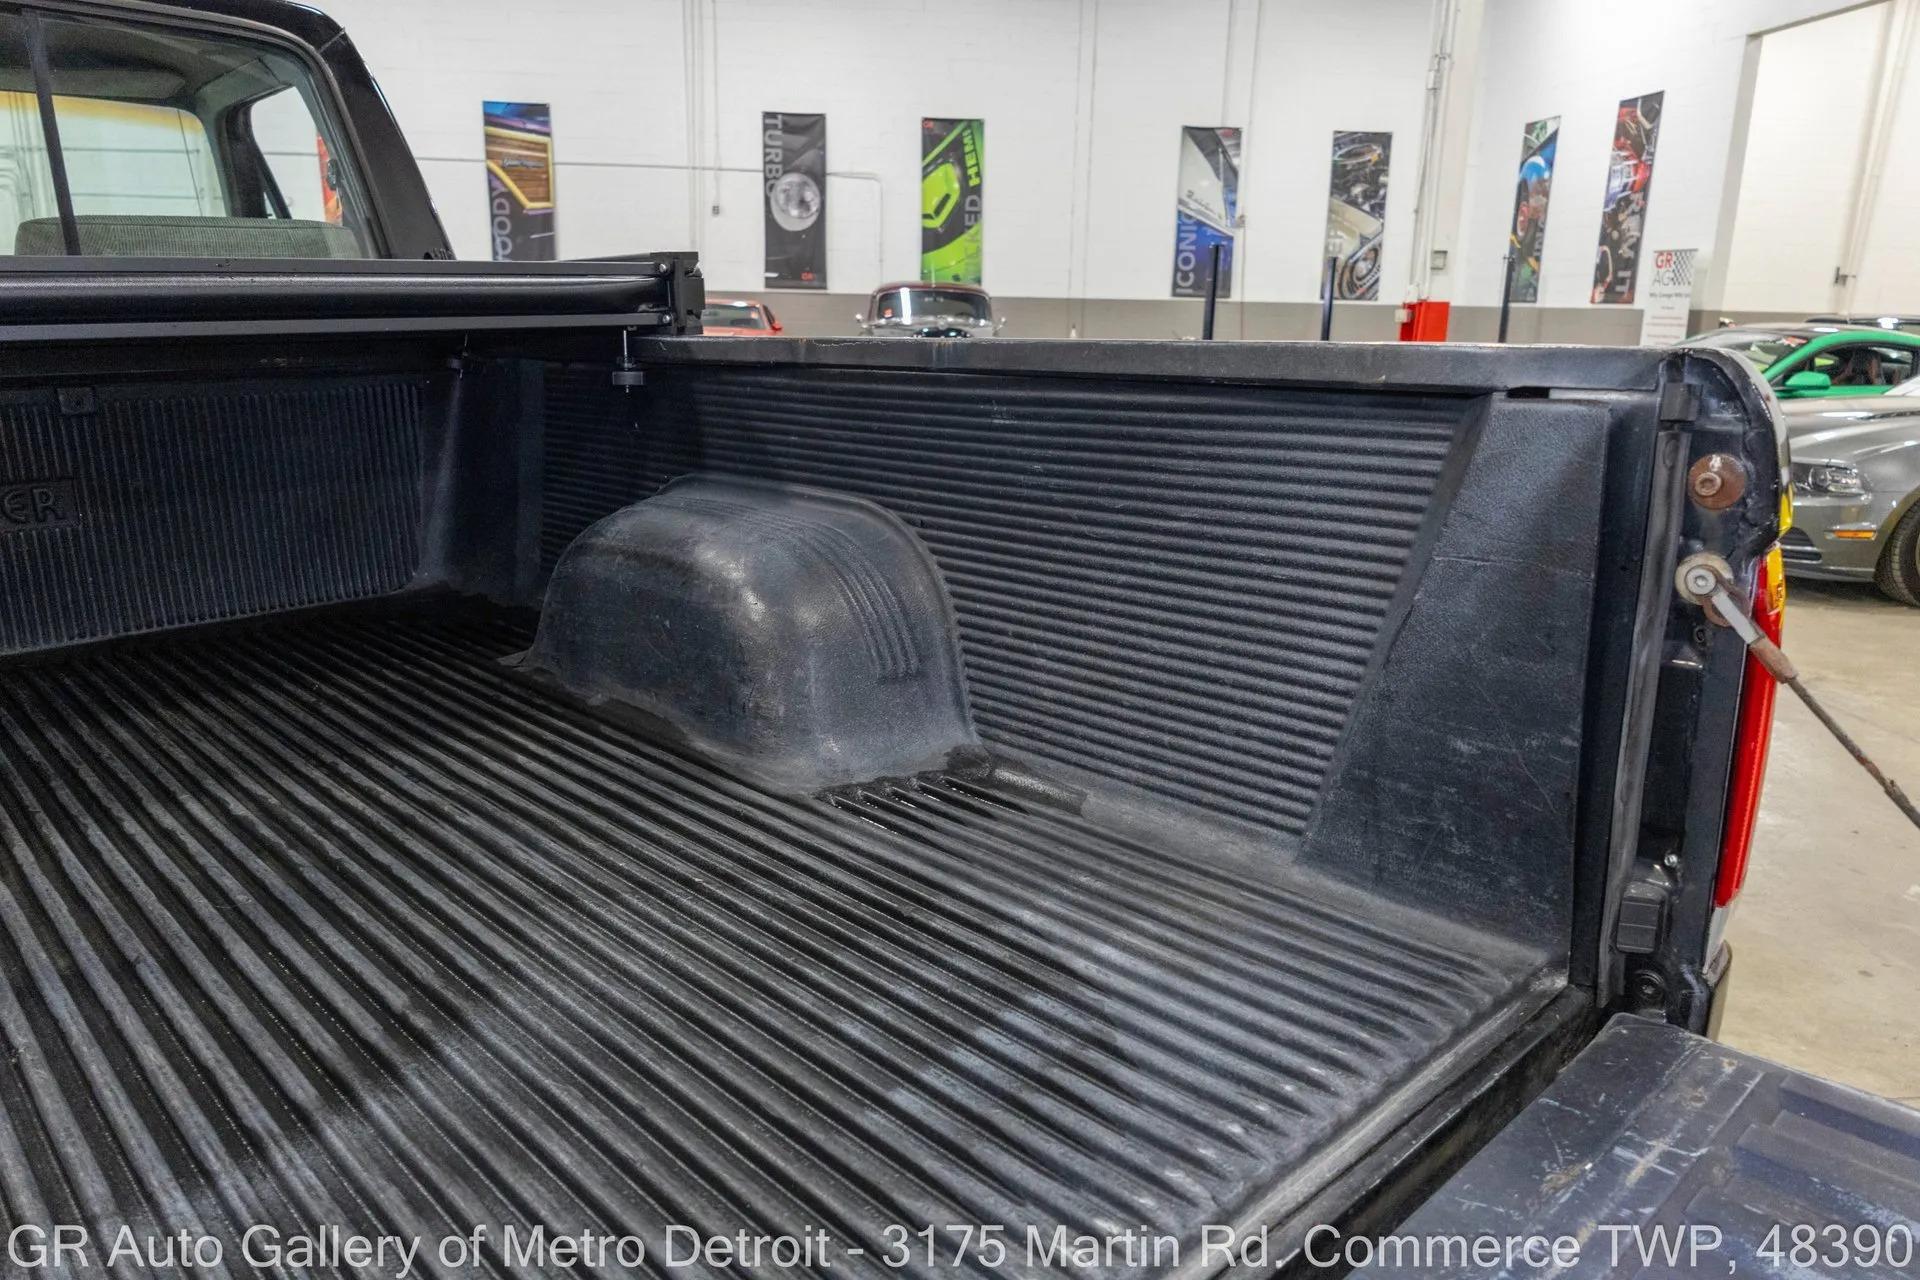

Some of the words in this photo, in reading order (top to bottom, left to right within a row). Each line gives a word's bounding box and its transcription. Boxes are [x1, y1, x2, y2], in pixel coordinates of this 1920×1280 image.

[962, 127, 981, 187] HEMI
[492, 185, 513, 261] OODY
[1655, 251, 1673, 269] GR
